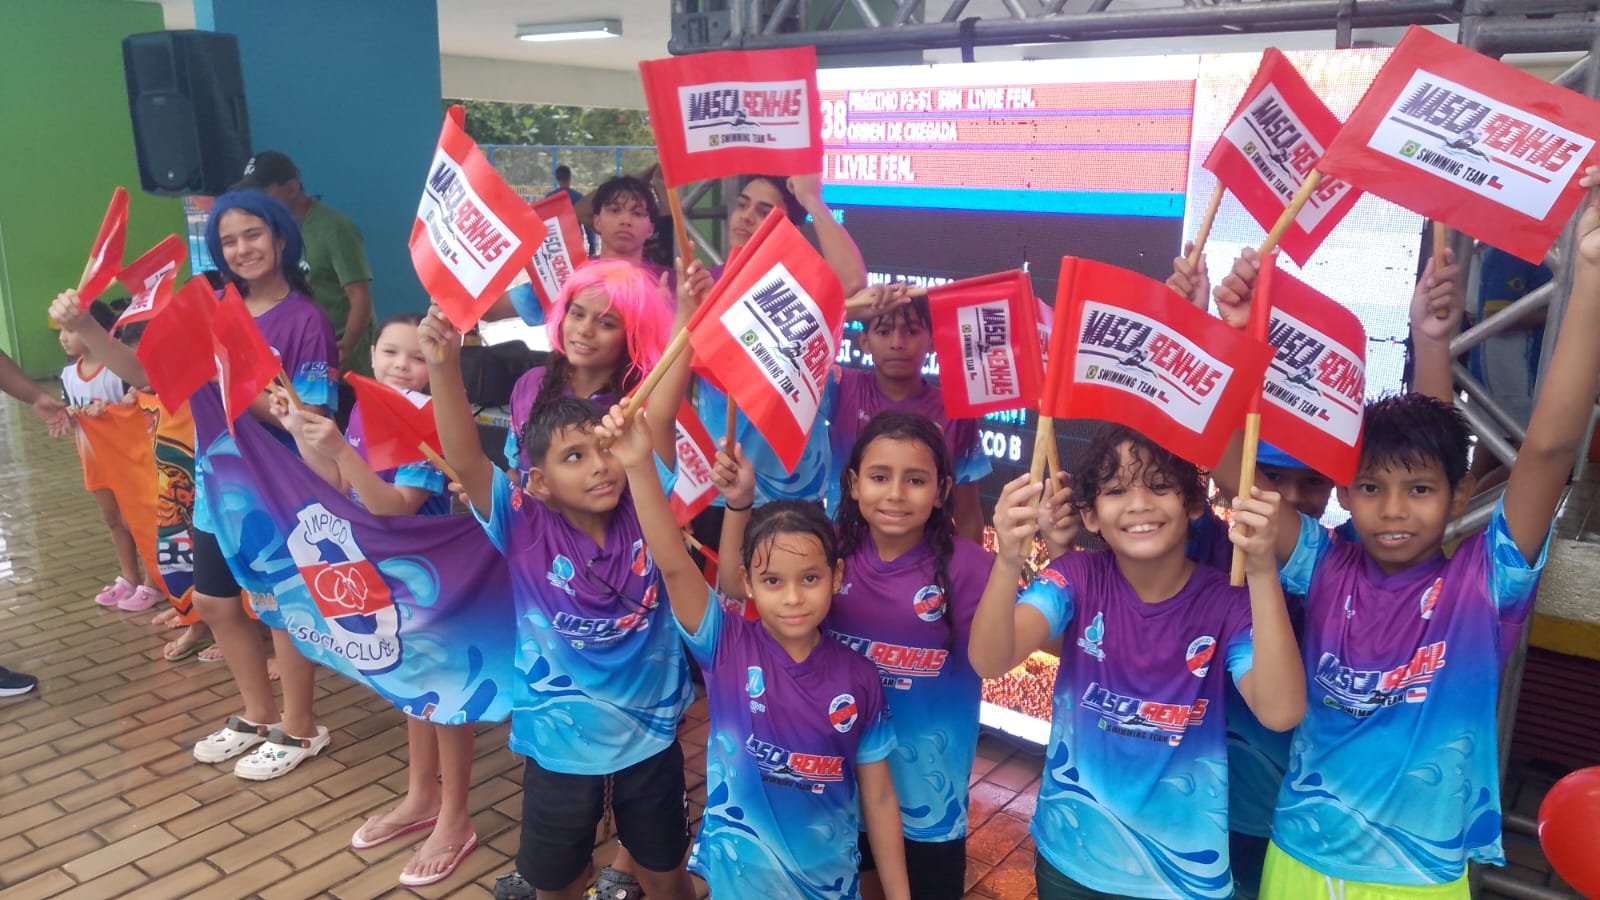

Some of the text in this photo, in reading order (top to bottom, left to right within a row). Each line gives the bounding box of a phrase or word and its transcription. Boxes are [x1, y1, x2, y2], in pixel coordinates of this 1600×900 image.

[967, 88, 1004, 110] LIVRE
[721, 133, 765, 144] SWIMMING TEAM
[887, 121, 902, 141] DE
[834, 154, 877, 180] LIVRE
[880, 154, 915, 181] FEM.
[1251, 152, 1289, 195] SWIMMING TEAM
[1416, 147, 1488, 187] SWIMMING TEAM
[751, 342, 796, 396] SWIMMING TEAM
[1097, 368, 1158, 398] SWIMMING TEAM
[1263, 380, 1320, 418] SWIMMING TEAM
[1009, 434, 1021, 461] B
